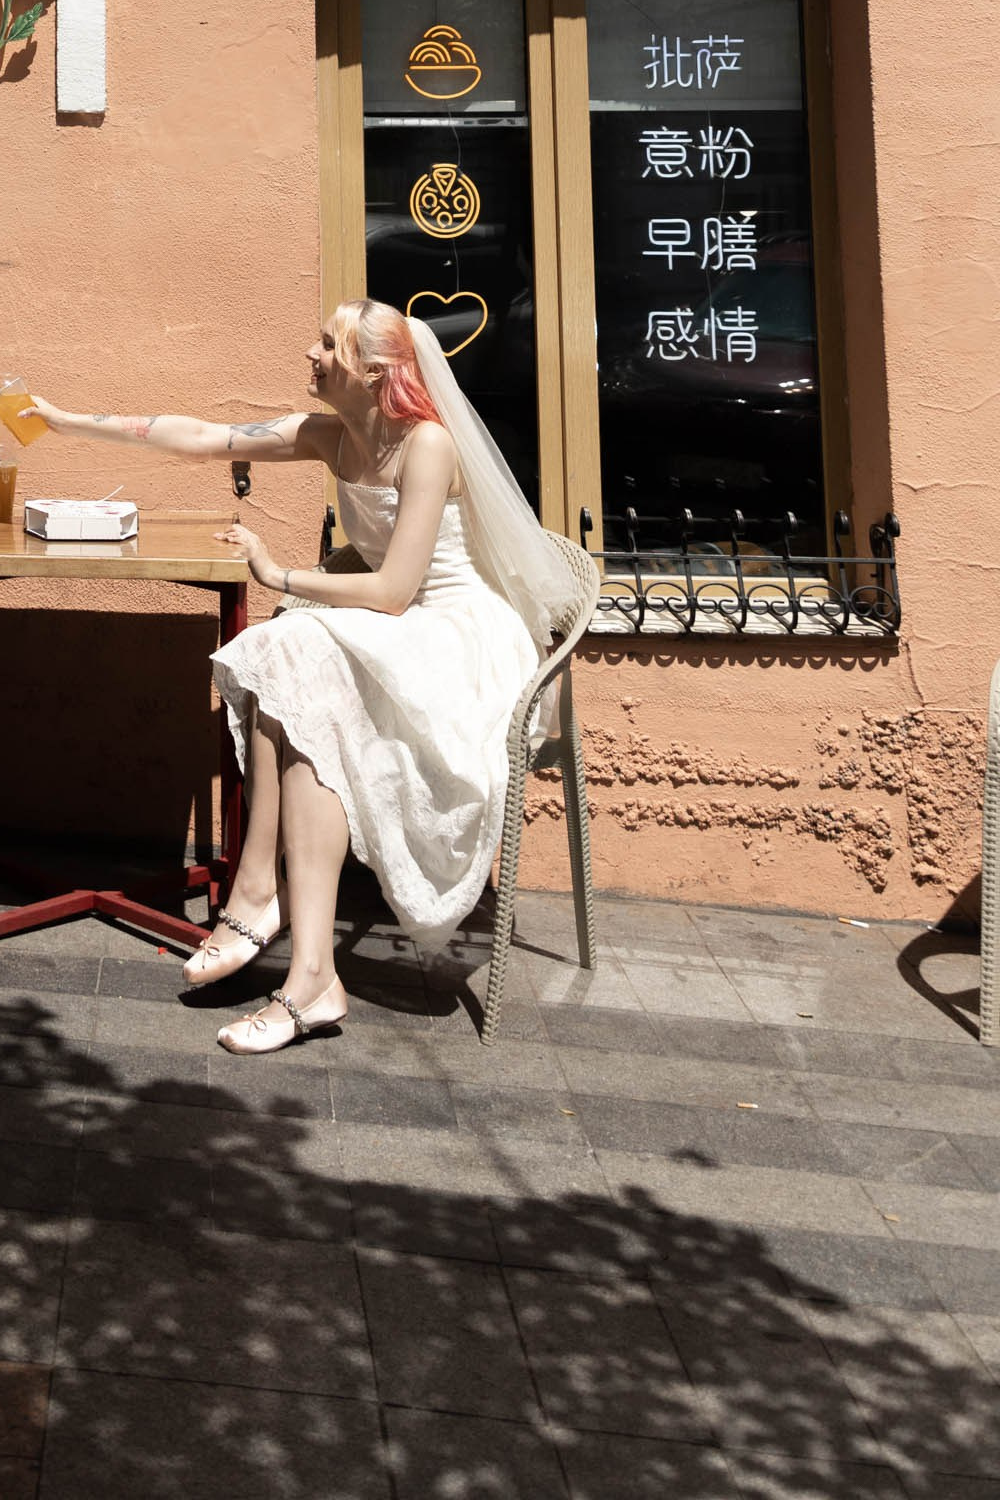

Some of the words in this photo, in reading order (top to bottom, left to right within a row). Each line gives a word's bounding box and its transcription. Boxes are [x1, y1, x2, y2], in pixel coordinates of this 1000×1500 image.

[643, 34, 745, 88] 批萨
[638, 126, 755, 179] 意粉
[642, 216, 758, 271] 早膳
[645, 306, 760, 363] 感情
